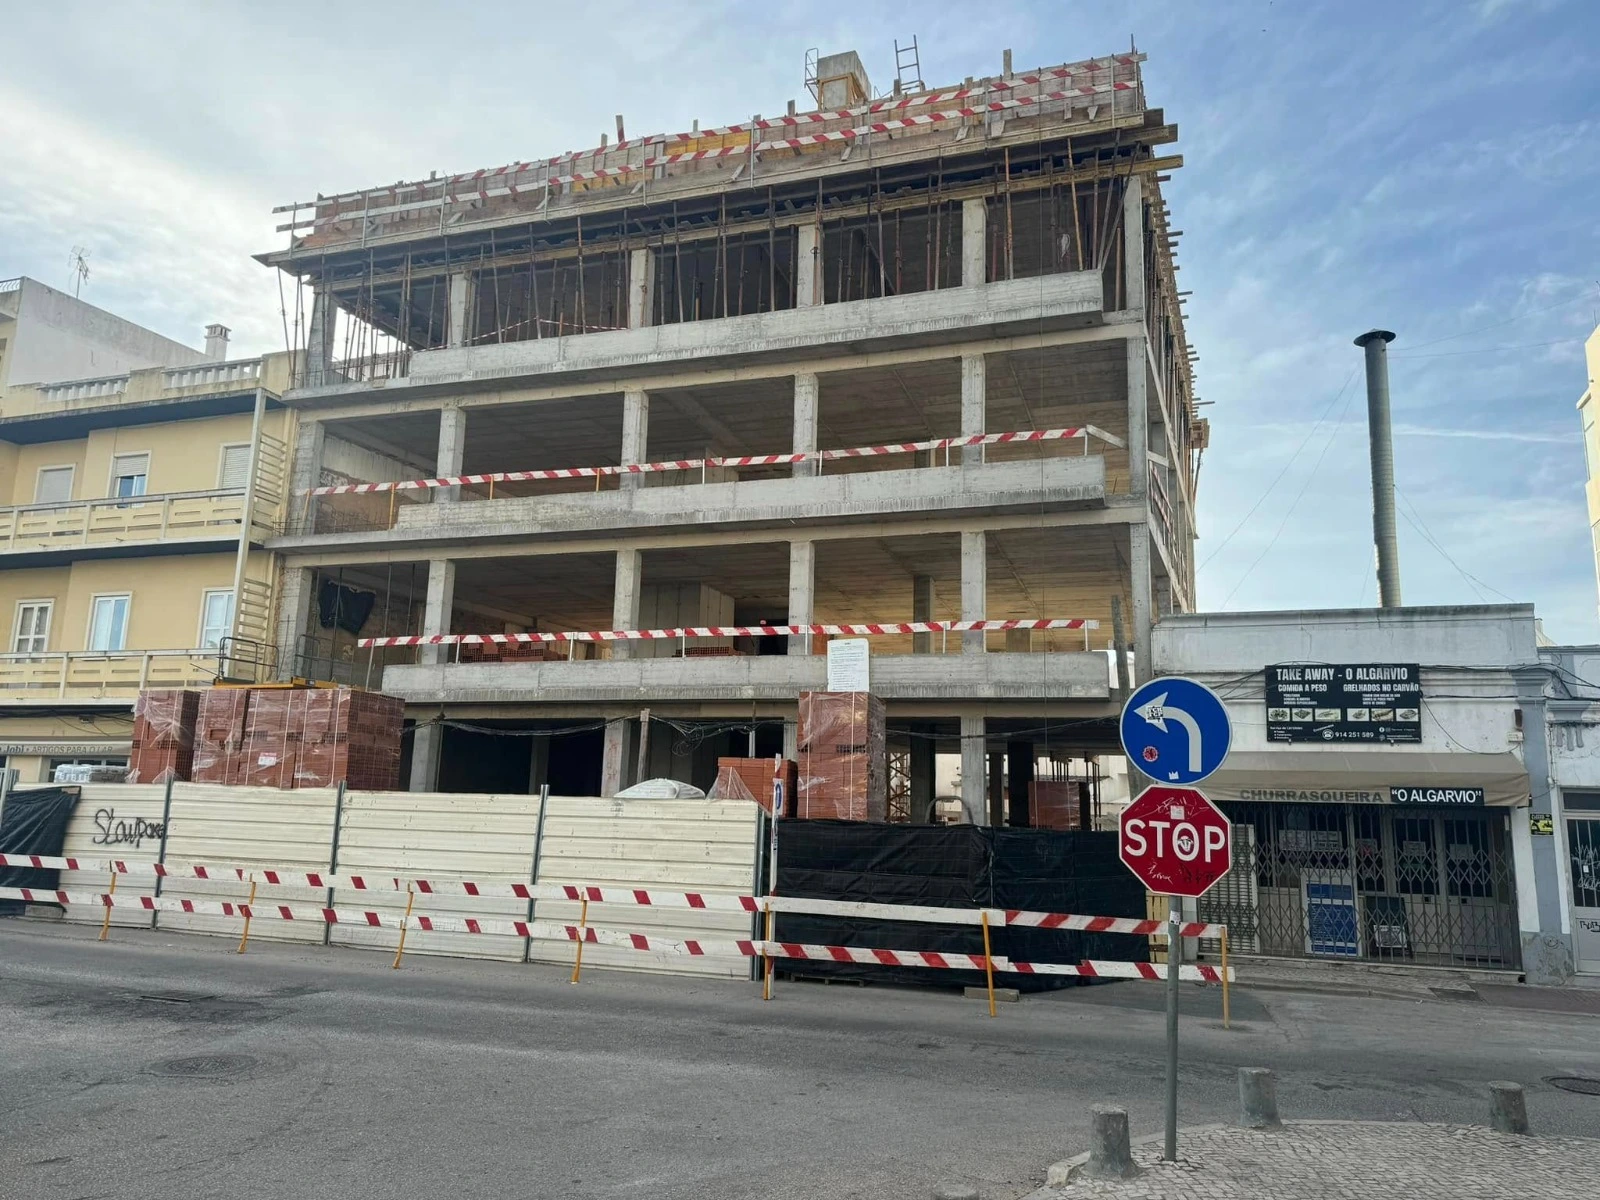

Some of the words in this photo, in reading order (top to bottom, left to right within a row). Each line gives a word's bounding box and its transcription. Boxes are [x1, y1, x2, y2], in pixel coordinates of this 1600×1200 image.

[1276, 668, 1302, 681] TAKE
[1304, 668, 1335, 680] AWAY
[1345, 667, 1353, 680] O
[1356, 667, 1408, 680] ALGARVIO
[1278, 684, 1303, 692] COMIDA
[1304, 684, 1310, 692] A
[1310, 683, 1328, 692] PESO
[1343, 683, 1381, 692] GRELHADOS
[1382, 683, 1392, 692] NO
[1392, 682, 1419, 692] CARVÃO
[31, 746, 66, 754] ARTIGOS
[66, 746, 87, 754] PARA
[1240, 789, 1384, 803] CHURRASQUEIRA
[1125, 818, 1226, 863] STOP
